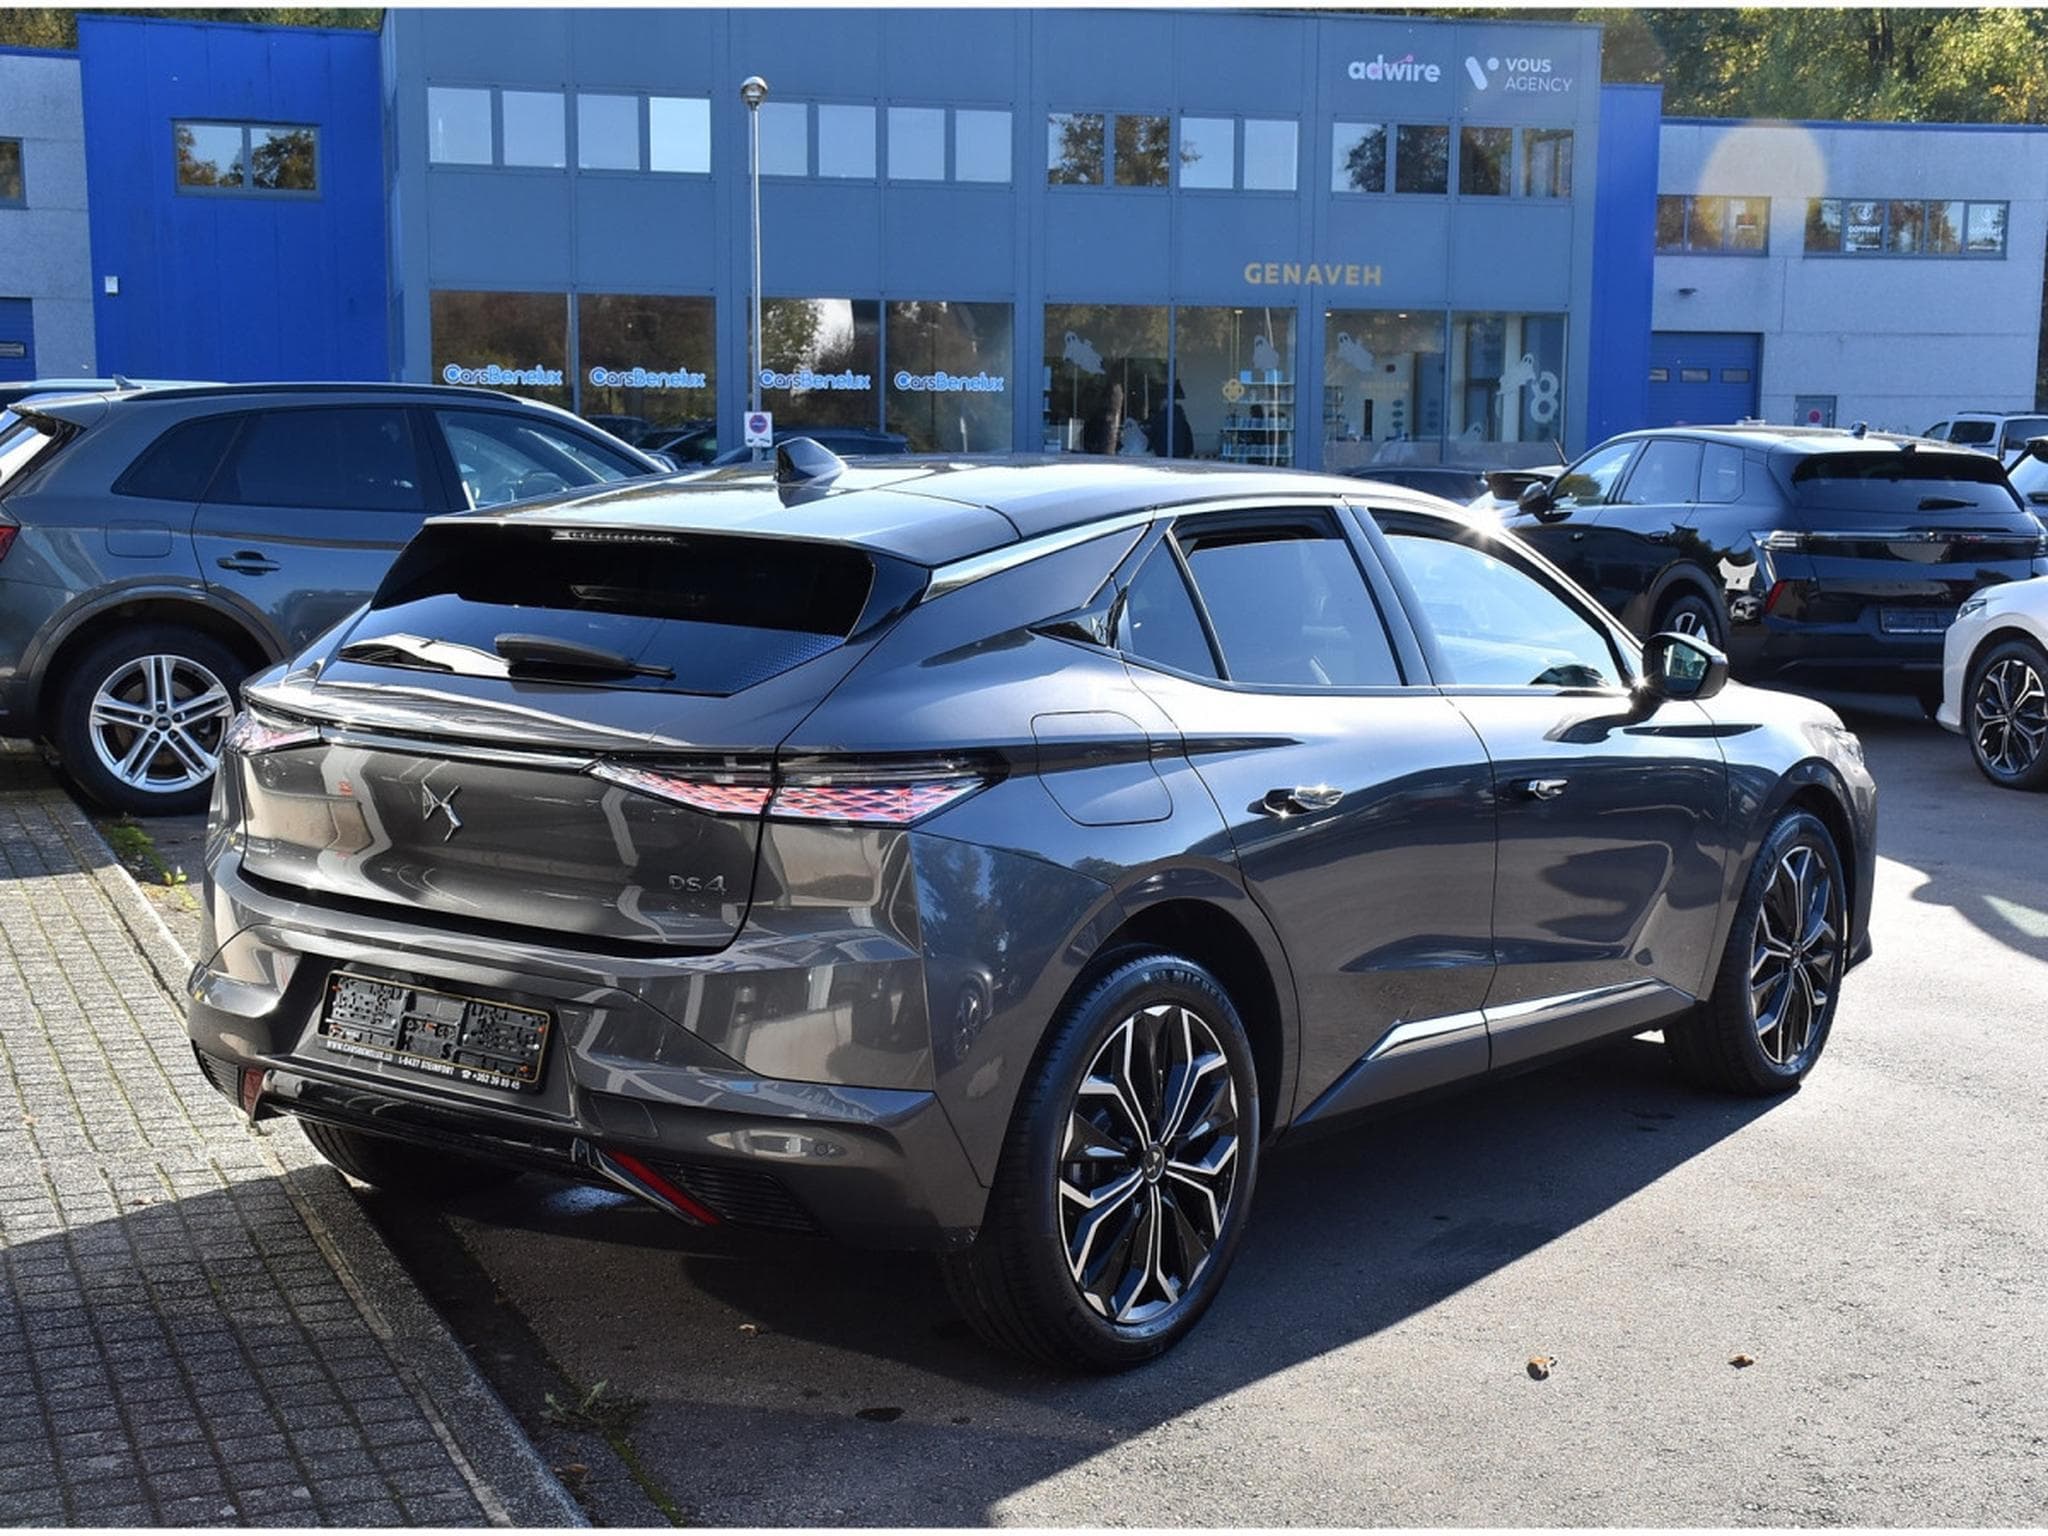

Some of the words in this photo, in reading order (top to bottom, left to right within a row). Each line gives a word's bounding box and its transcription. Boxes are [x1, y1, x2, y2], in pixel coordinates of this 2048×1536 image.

[1348, 54, 1441, 83] adwire
[1505, 58, 1552, 73] VOUS
[1504, 76, 1573, 92] AGENCY
[1244, 263, 1382, 286] GENAVEH
[443, 364, 563, 386] CarsBenelux
[589, 366, 706, 388] CarsBenelux
[759, 368, 871, 390] CarsBenelux
[894, 371, 1005, 392] CarsBenelux
